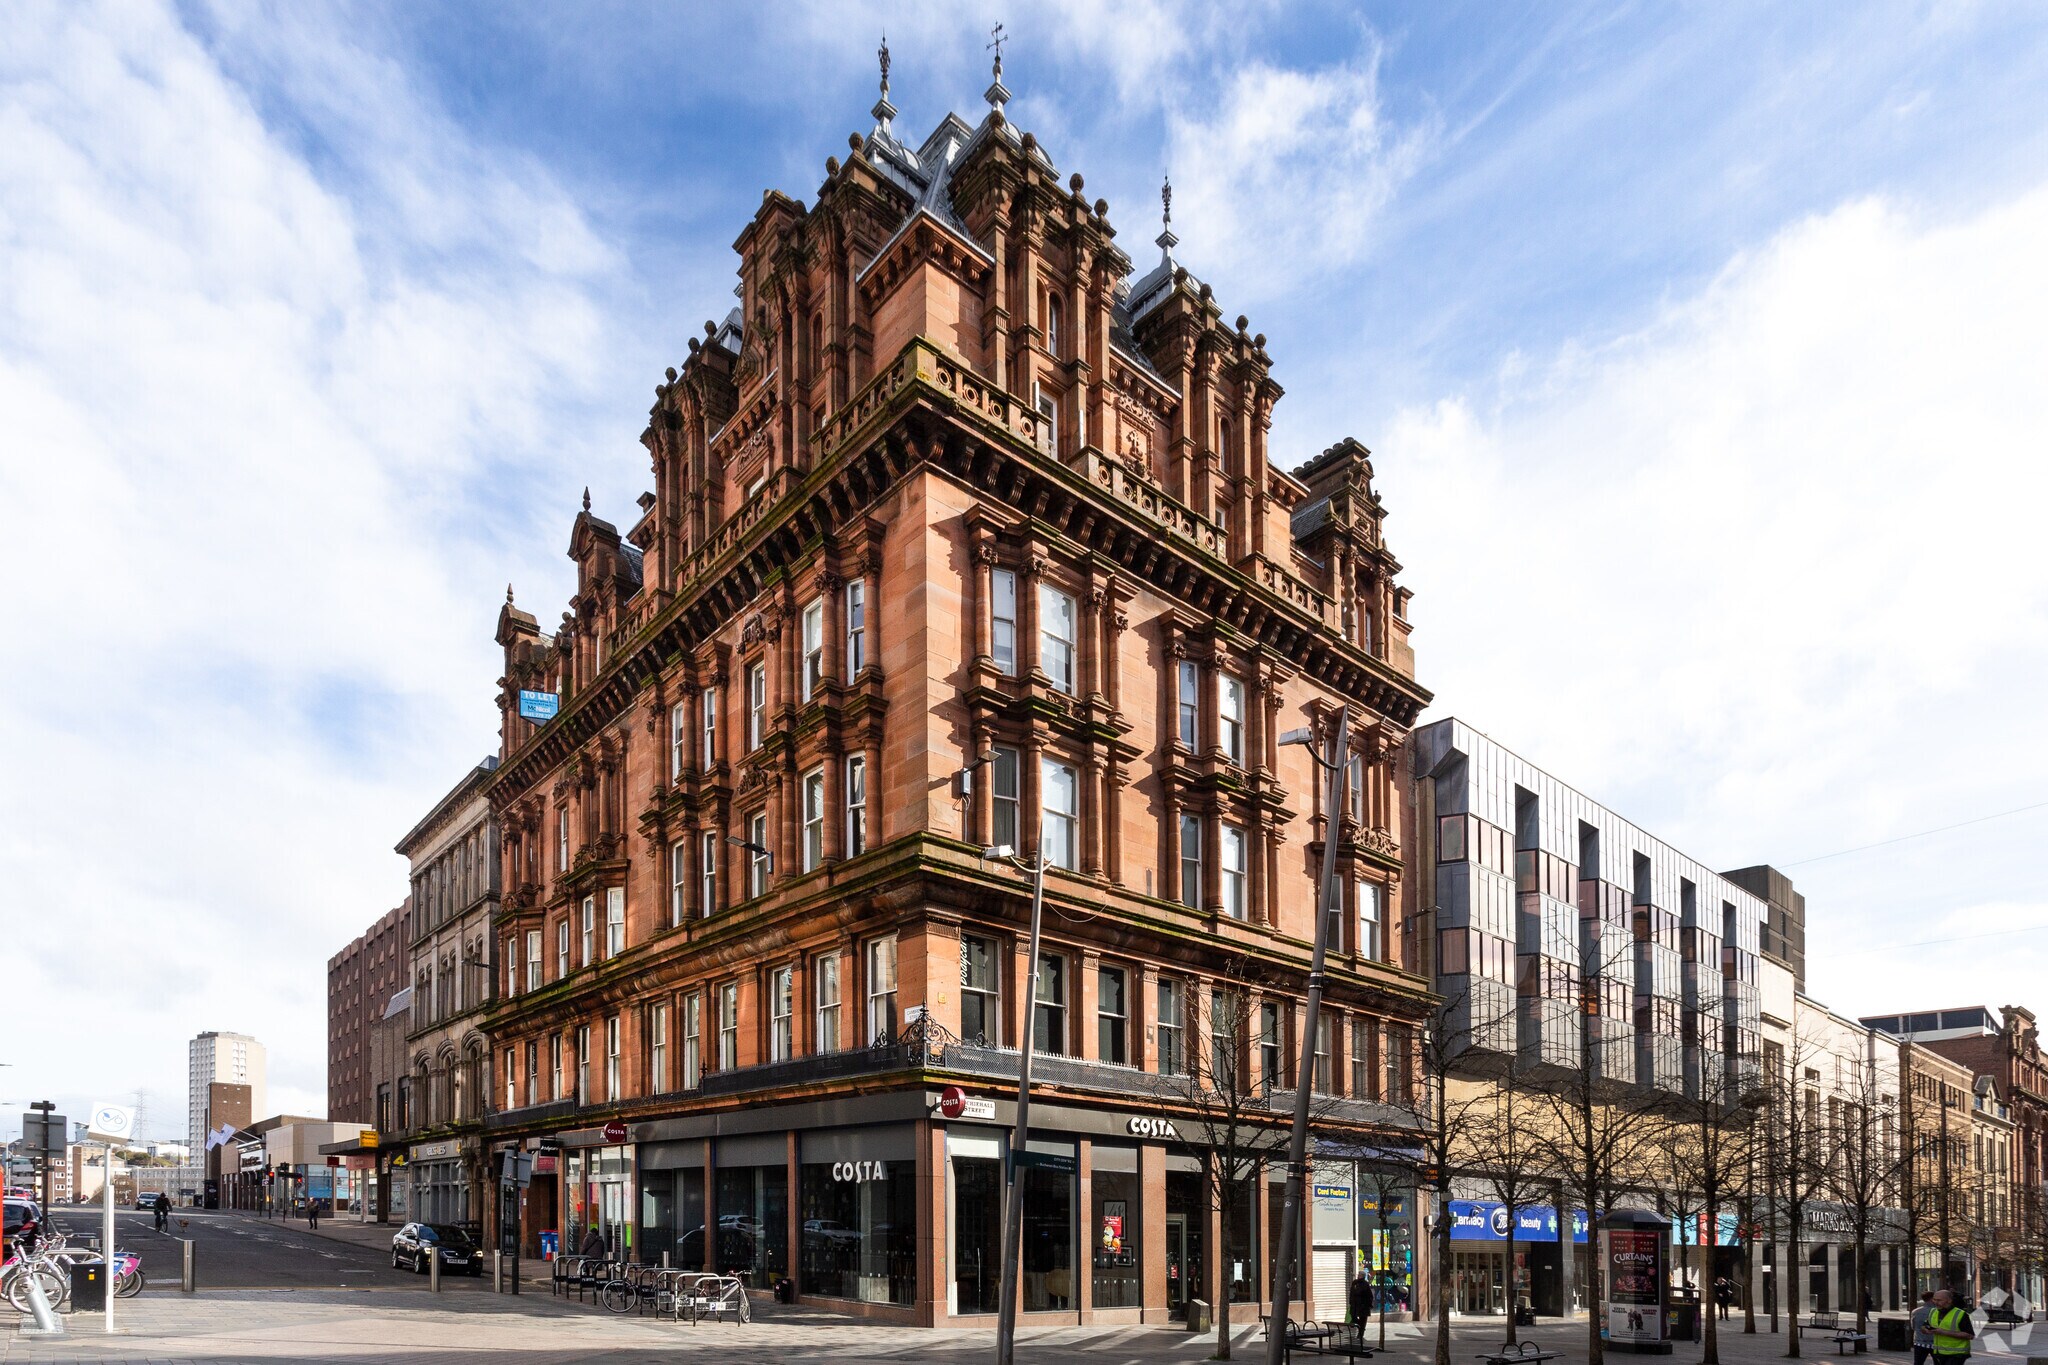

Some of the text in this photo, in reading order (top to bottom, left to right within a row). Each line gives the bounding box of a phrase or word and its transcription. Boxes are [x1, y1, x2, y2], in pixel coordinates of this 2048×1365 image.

[523, 691, 536, 699] TO
[537, 692, 555, 701] LET
[942, 1099, 959, 1107] COSTA
[965, 1101, 994, 1109] CHIEHALL
[1131, 1117, 1176, 1137] COSTA
[832, 1161, 884, 1184] COSTA
[1317, 1188, 1348, 1198] Card Factory
[1363, 1200, 1378, 1210] Card
[1520, 1216, 1542, 1230] beauty
[1613, 1253, 1654, 1265] CURTAINS
